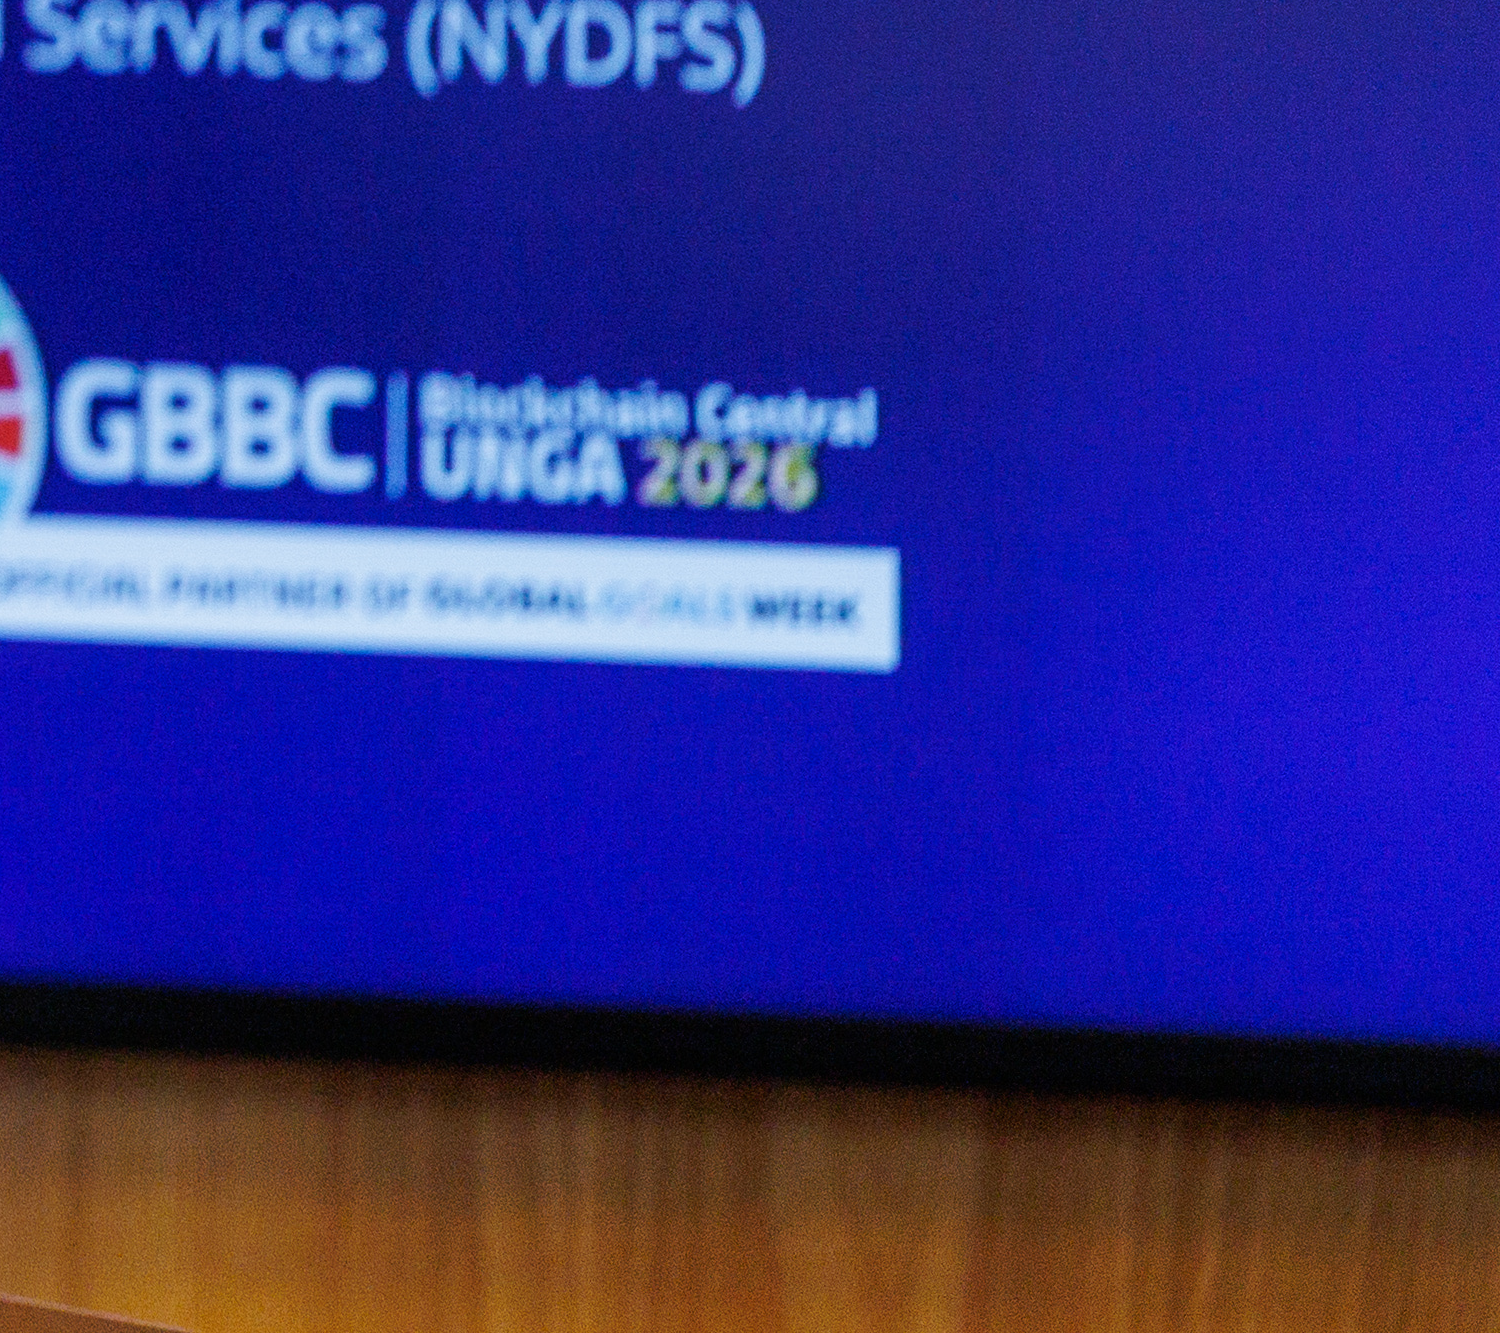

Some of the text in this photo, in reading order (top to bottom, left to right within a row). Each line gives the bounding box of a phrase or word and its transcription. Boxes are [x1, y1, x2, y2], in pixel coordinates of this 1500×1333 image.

[56, 361, 376, 491] GBBC
[418, 372, 878, 448] Blockchain Central
[420, 429, 823, 511] UNGA 2026
